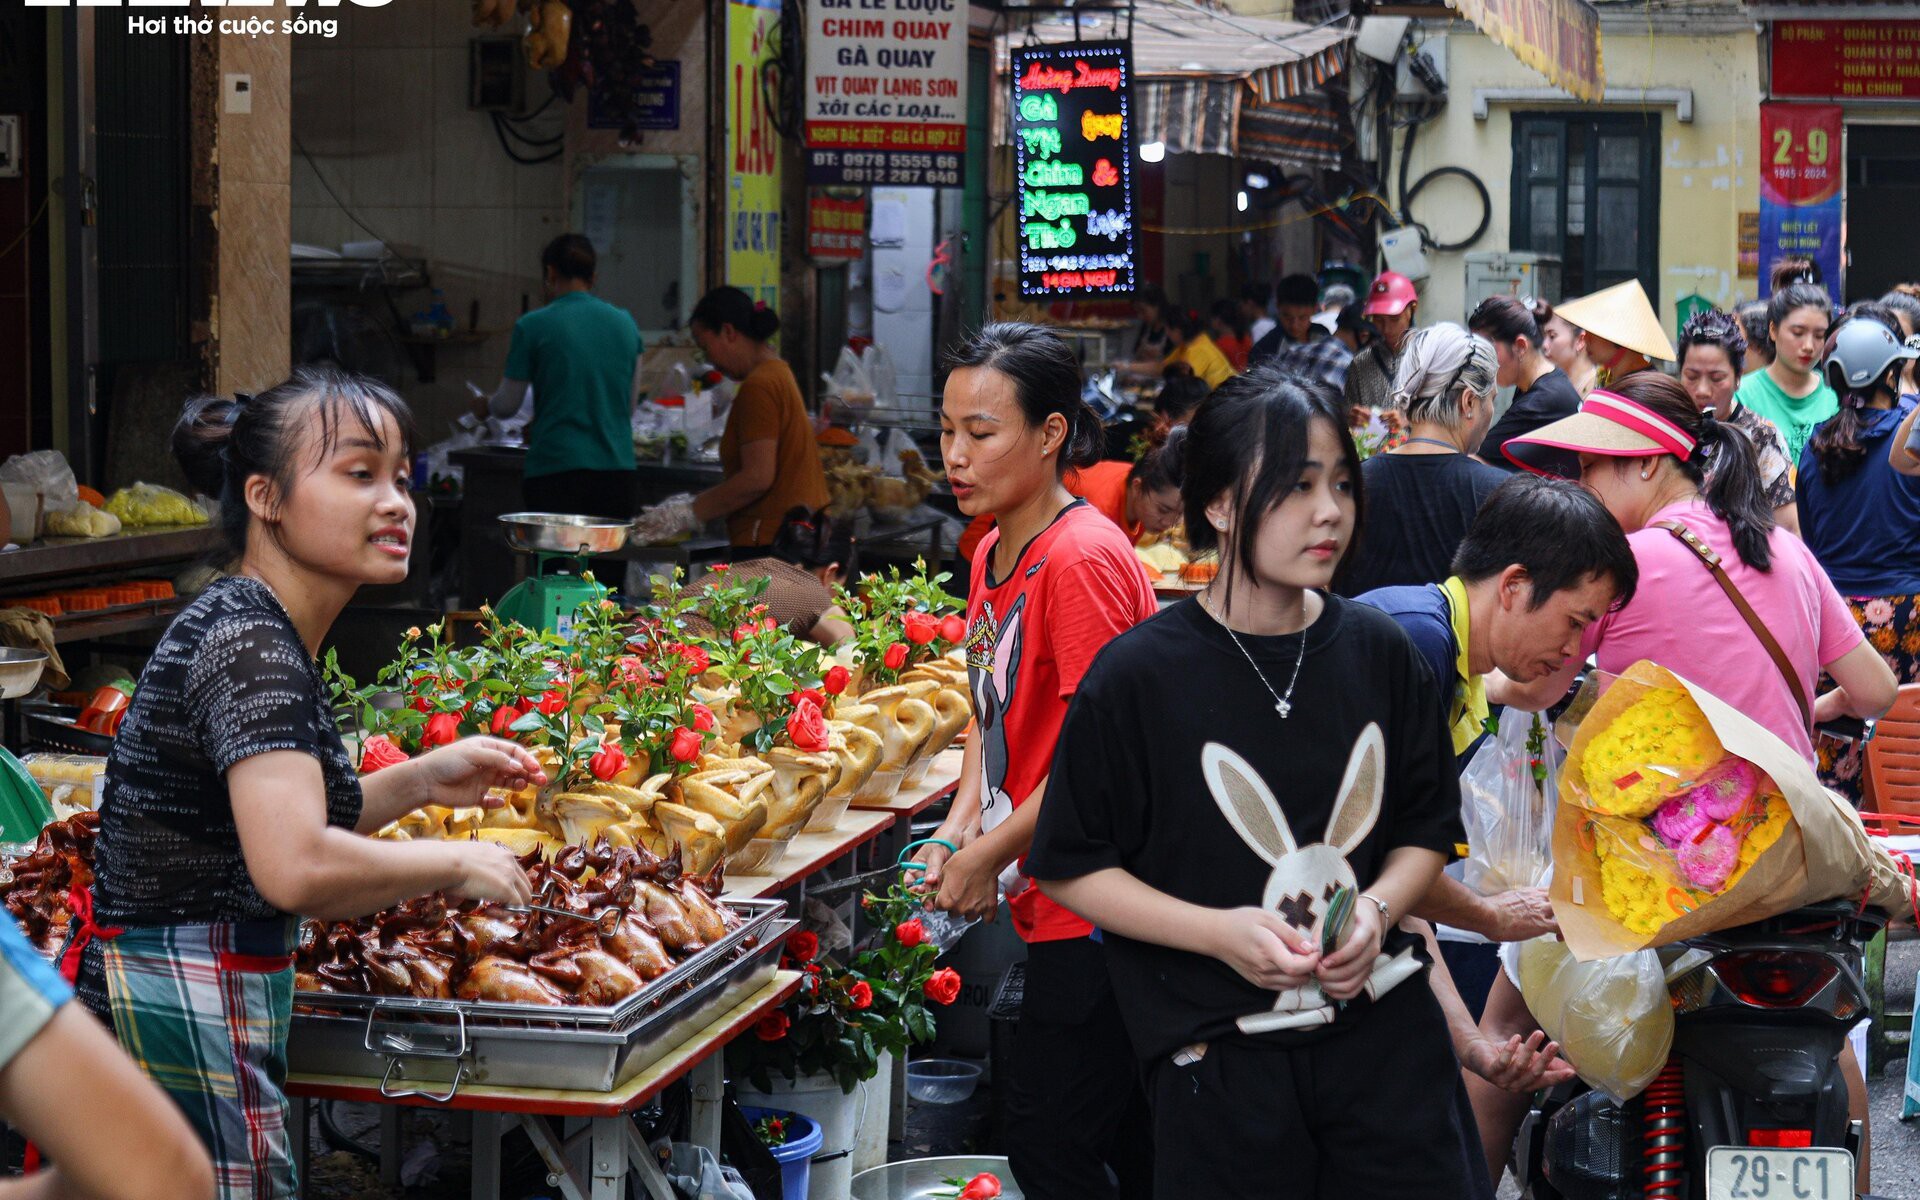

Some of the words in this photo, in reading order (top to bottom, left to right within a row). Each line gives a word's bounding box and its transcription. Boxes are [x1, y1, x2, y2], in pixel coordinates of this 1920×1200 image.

[822, 19, 885, 38] CHIM
[893, 20, 952, 41] QUAY
[837, 44, 869, 67] GÀ
[877, 49, 936, 69] QUAY
[815, 75, 838, 98] VỊT
[842, 77, 879, 96] QUAY
[883, 78, 922, 100] LẠNG
[927, 77, 959, 97] SƠN
[817, 99, 850, 116] XÔI
[855, 100, 892, 117] CÁC
[1020, 93, 1058, 121] Gà
[843, 153, 886, 167] 0978
[890, 154, 932, 168] 5555
[936, 156, 958, 169] 66
[842, 168, 885, 182] 0912
[889, 169, 921, 183] 287
[925, 170, 958, 184] 640
[1023, 160, 1083, 187] Chim
[1774, 167, 1796, 179] 1945
[1804, 167, 1828, 179] 2024
[1023, 189, 1090, 221] Ngan
